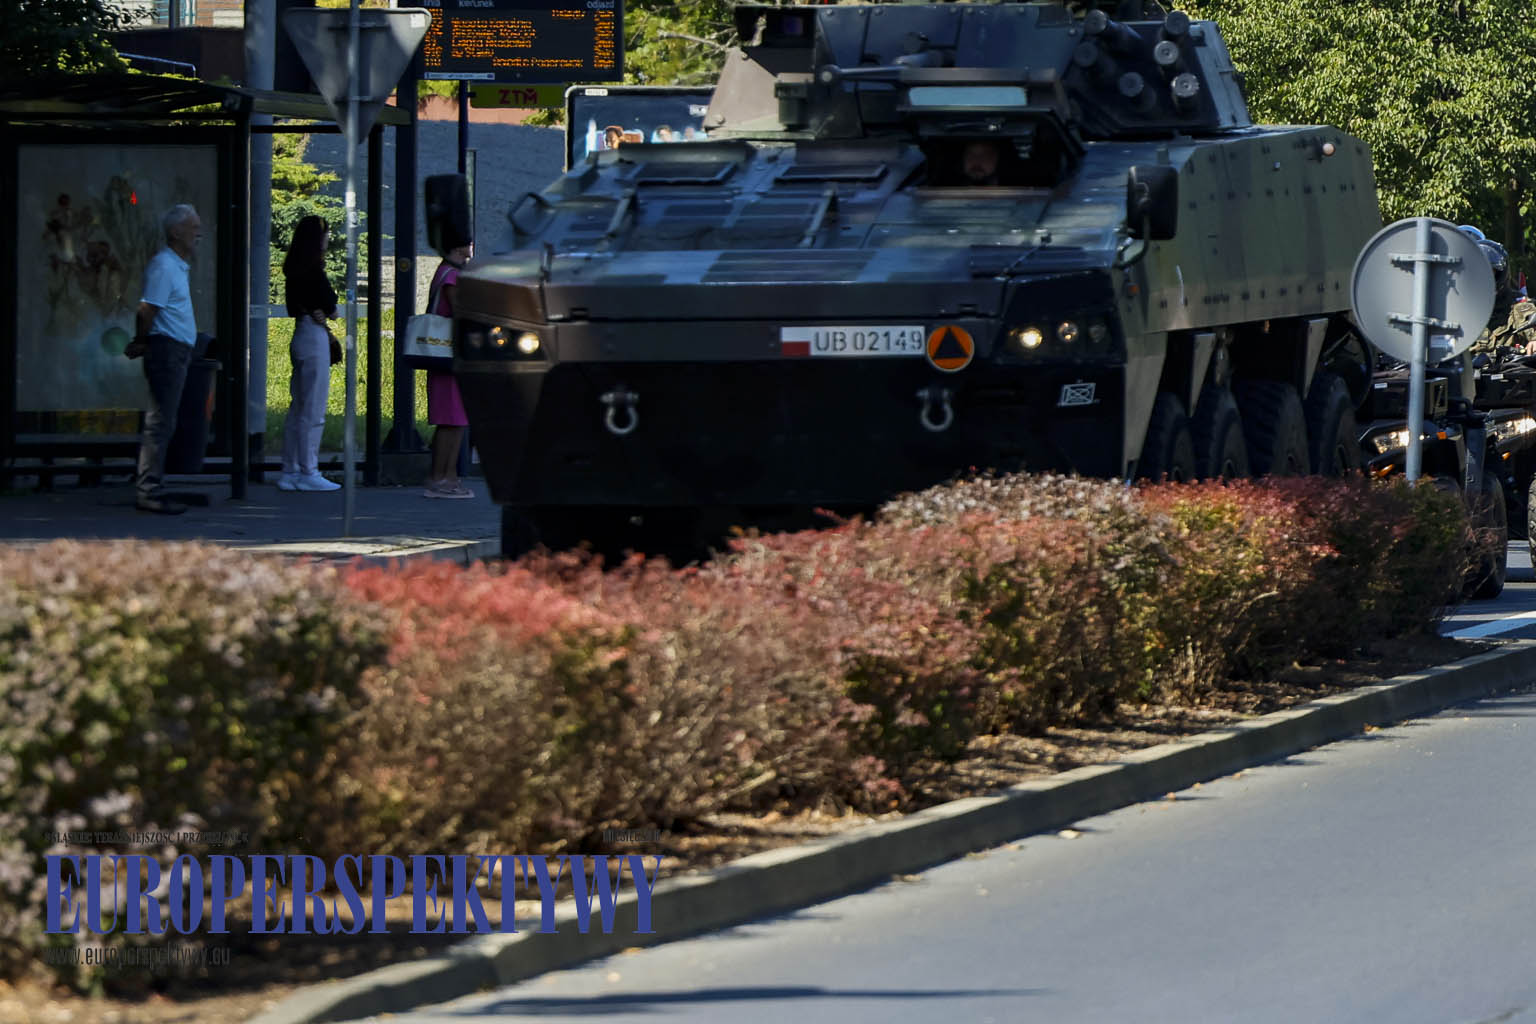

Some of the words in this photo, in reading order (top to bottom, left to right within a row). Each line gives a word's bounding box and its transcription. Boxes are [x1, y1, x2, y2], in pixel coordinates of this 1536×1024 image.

[498, 88, 537, 105] ZTM
[815, 331, 848, 352] UB
[853, 330, 923, 352] 02149
